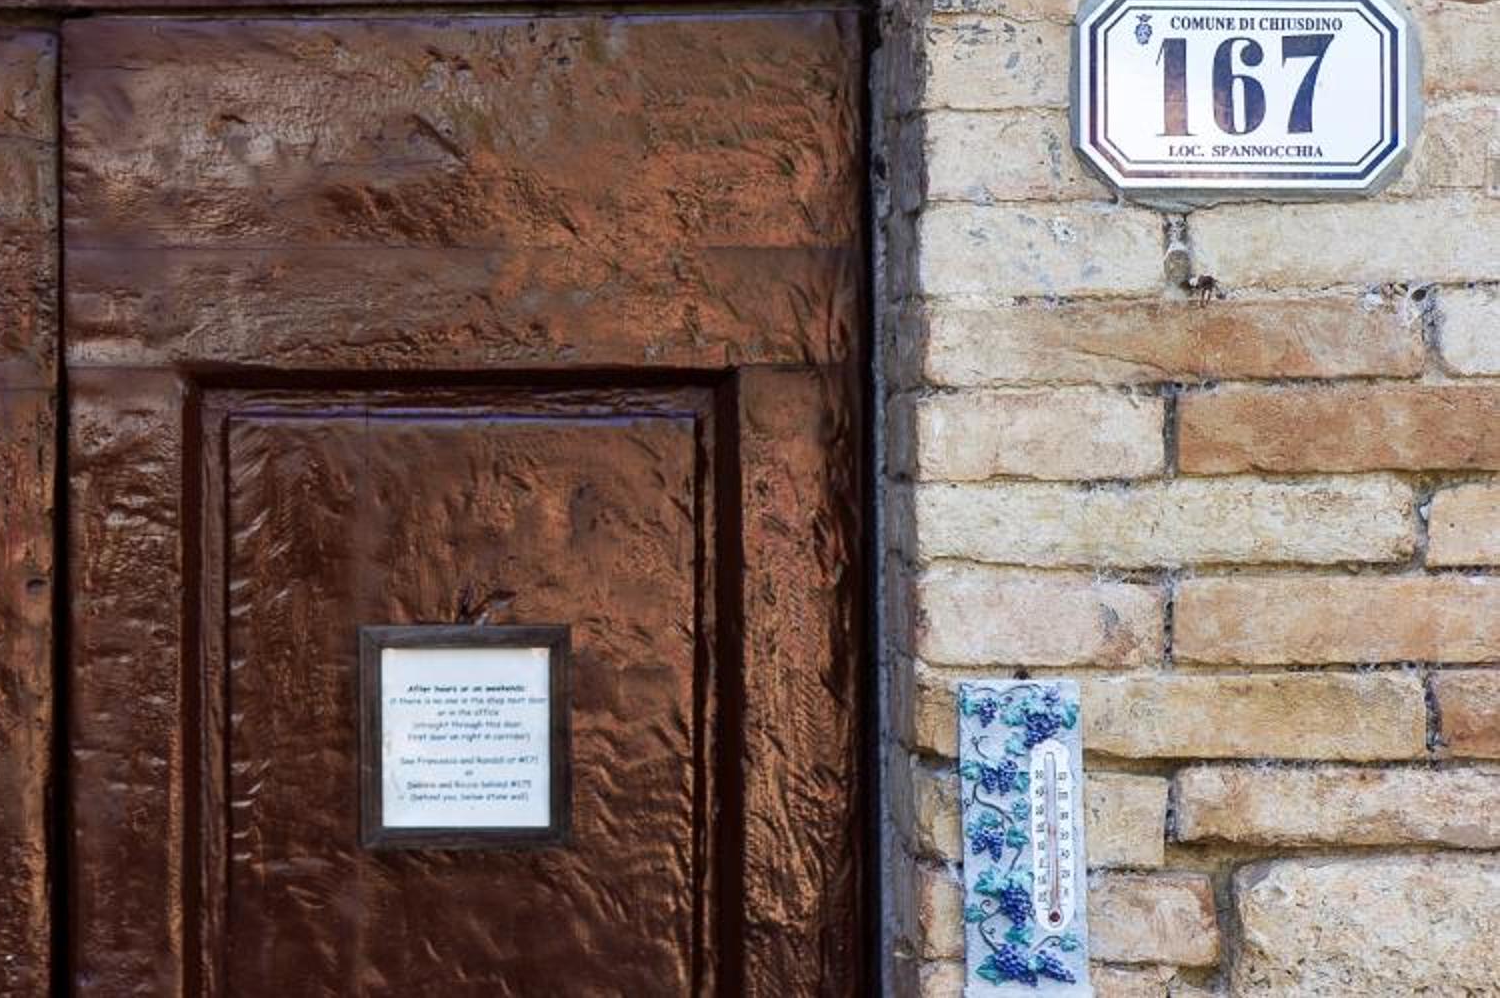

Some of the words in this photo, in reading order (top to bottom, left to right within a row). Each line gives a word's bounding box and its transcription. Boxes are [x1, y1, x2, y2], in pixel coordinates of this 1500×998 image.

[1170, 16, 1236, 31] COMUNE
[1239, 16, 1257, 31] DI
[1259, 16, 1343, 32] CHIUSDINO
[1156, 34, 1335, 136] 167
[1168, 145, 1205, 157] LOC.
[1211, 145, 1323, 157] SPANNOCCHIA
[407, 684, 431, 693] After
[435, 684, 457, 693] hours
